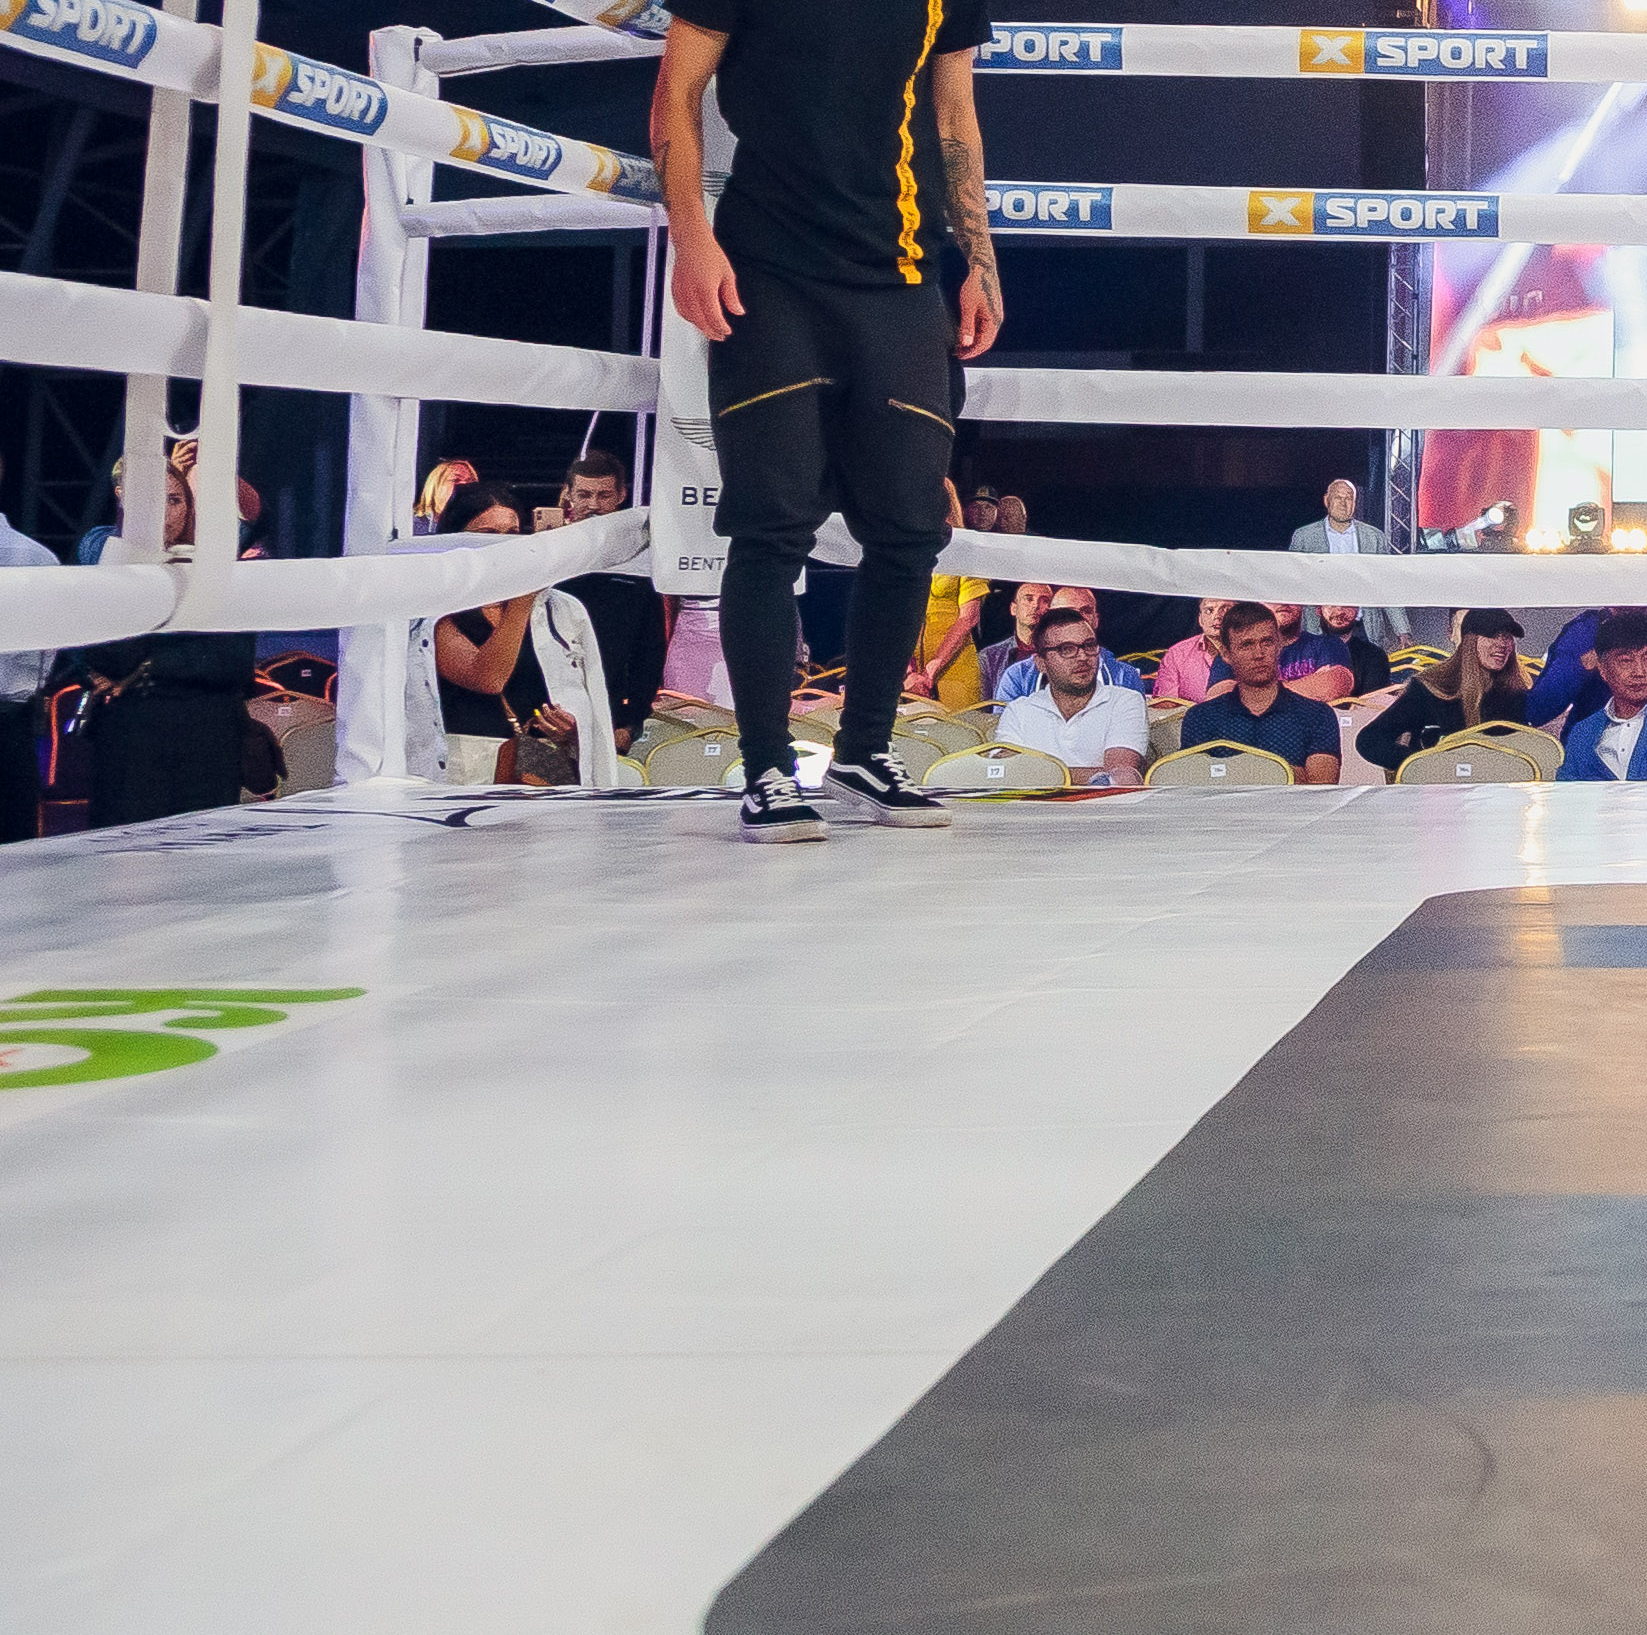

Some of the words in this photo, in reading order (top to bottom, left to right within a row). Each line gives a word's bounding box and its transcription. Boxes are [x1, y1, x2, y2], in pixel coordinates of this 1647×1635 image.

[973, 32, 1110, 62] PORT
[1376, 37, 1538, 69] SPORT
[288, 68, 385, 122] SPORT
[488, 128, 559, 172] SPORT
[985, 192, 1101, 222] PORT
[1326, 199, 1488, 230] SPORT
[678, 556, 726, 571] BENT
